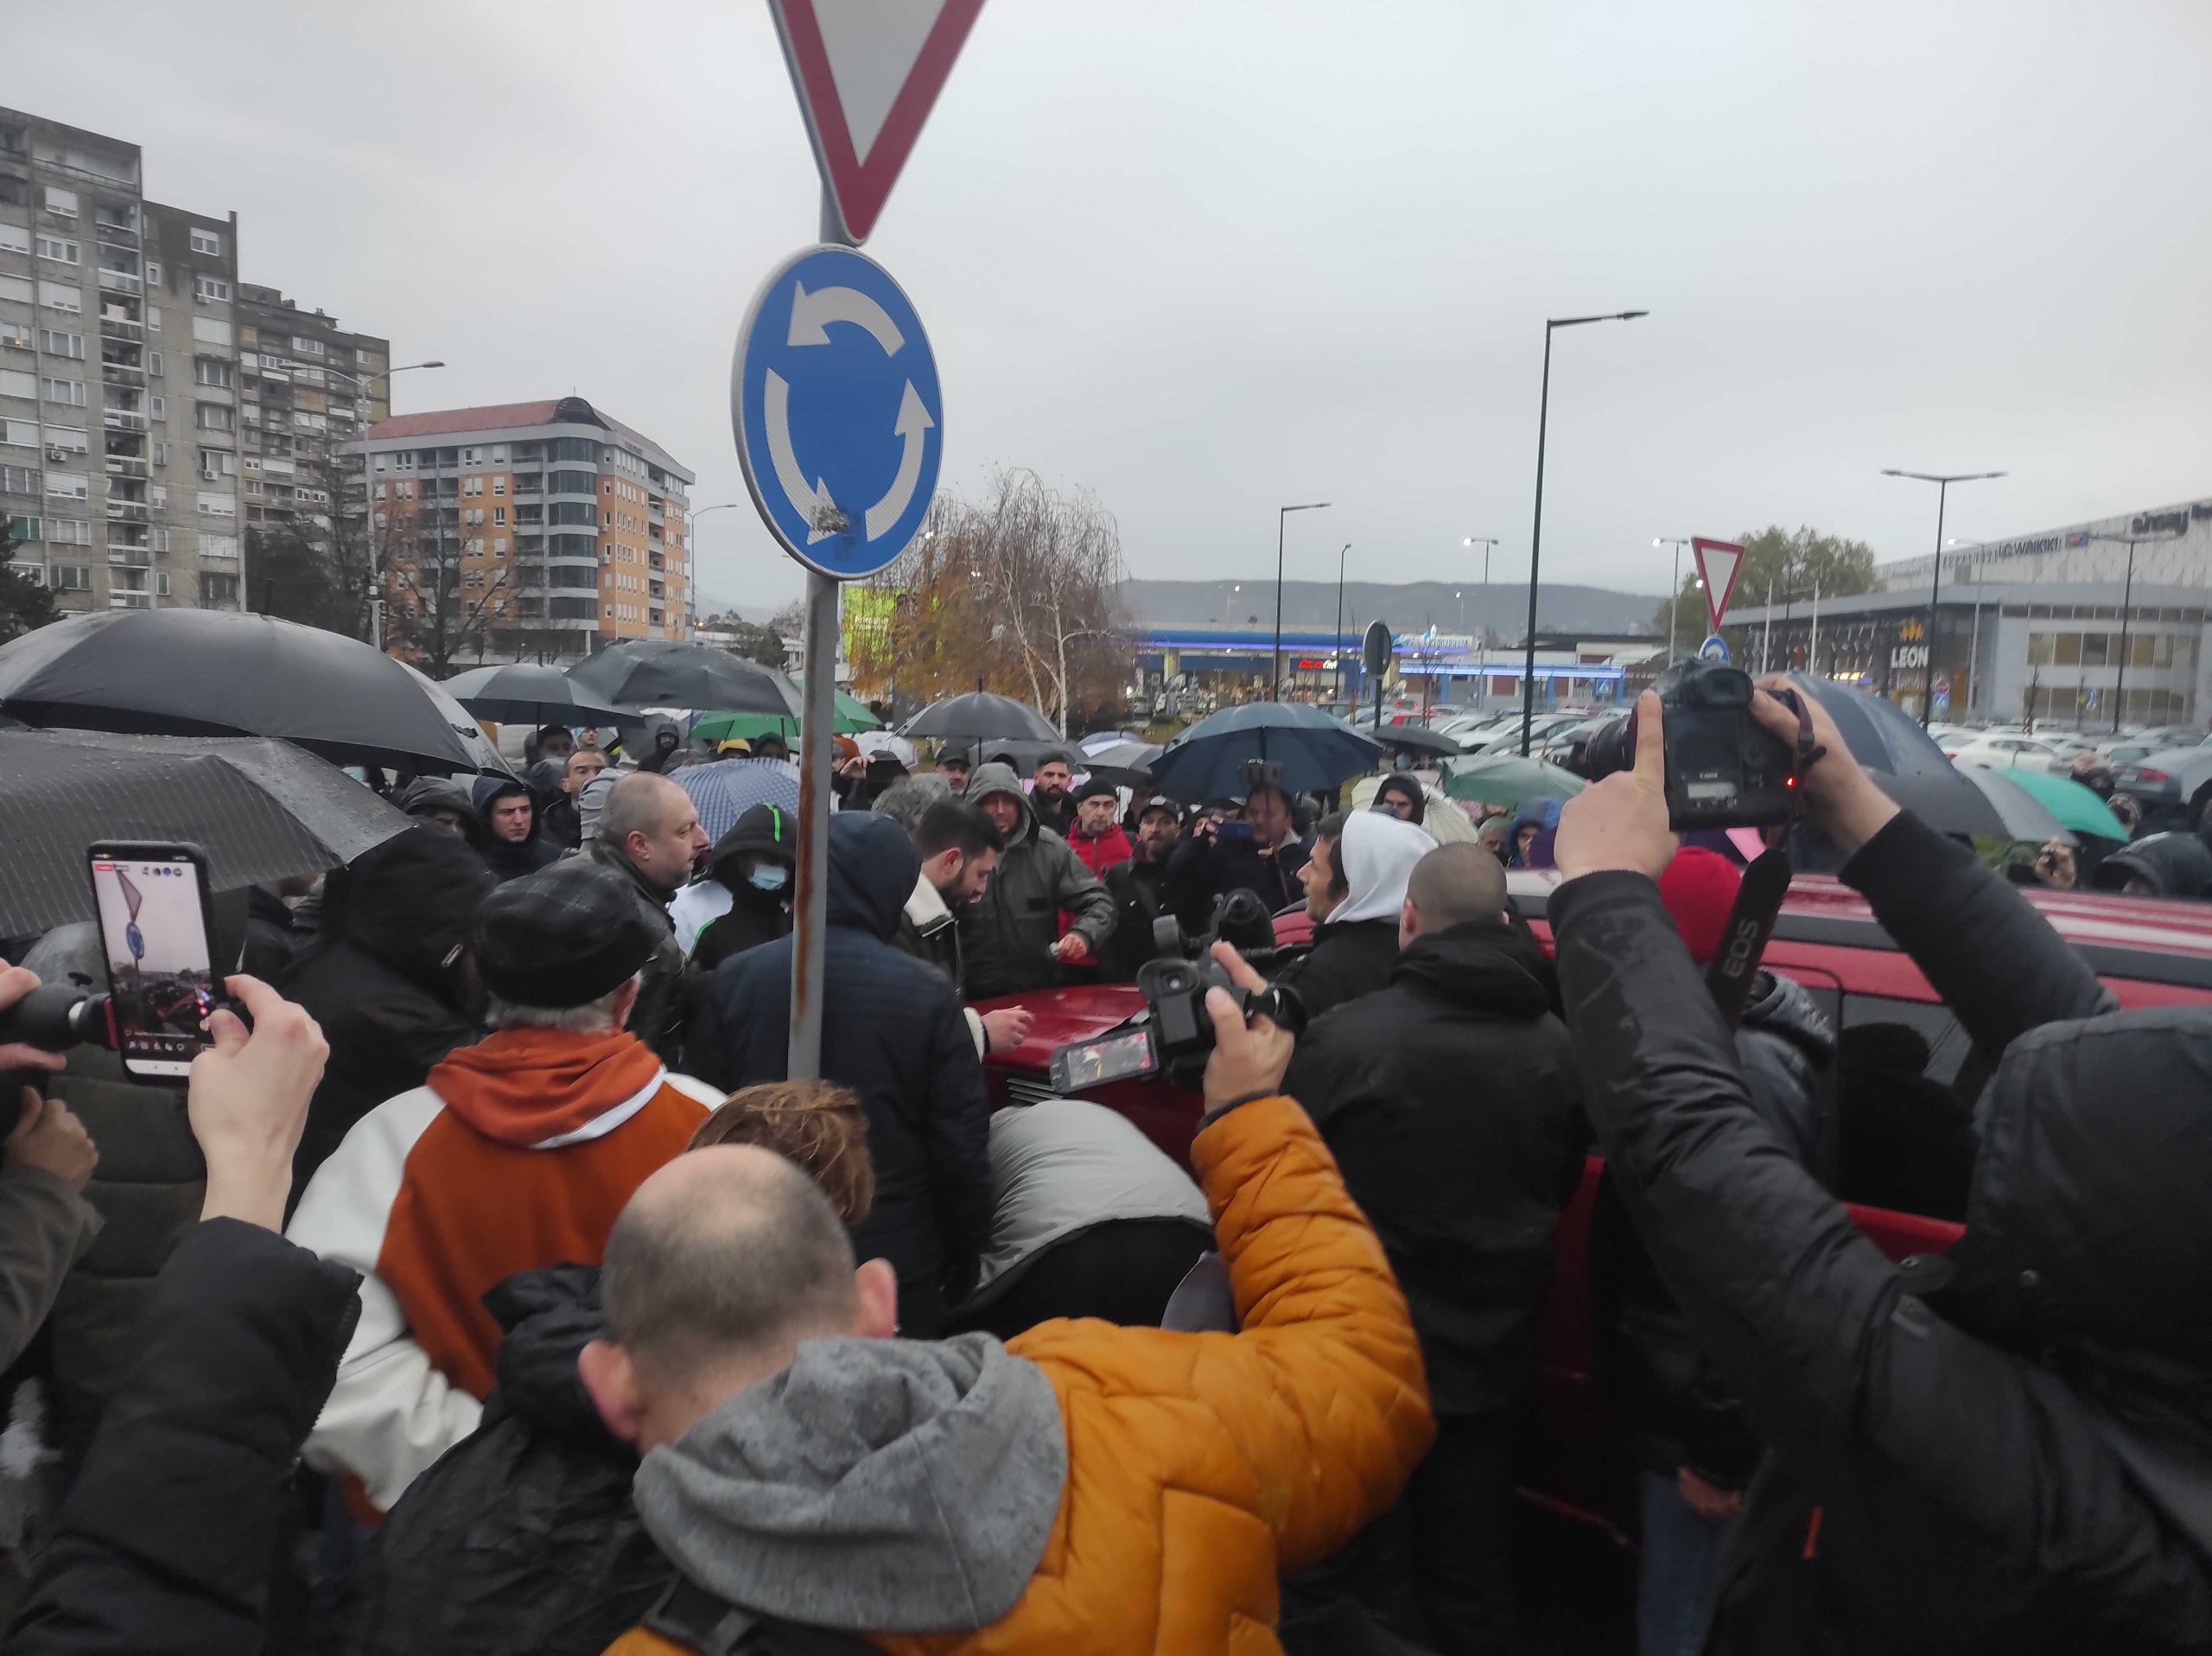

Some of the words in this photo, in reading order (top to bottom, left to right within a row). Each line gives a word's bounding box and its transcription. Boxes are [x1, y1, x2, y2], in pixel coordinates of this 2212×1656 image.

[2014, 537, 2060, 554] WAIKIKI
[1891, 645, 1929, 669] LEON
[1722, 918, 1759, 978] EOS
